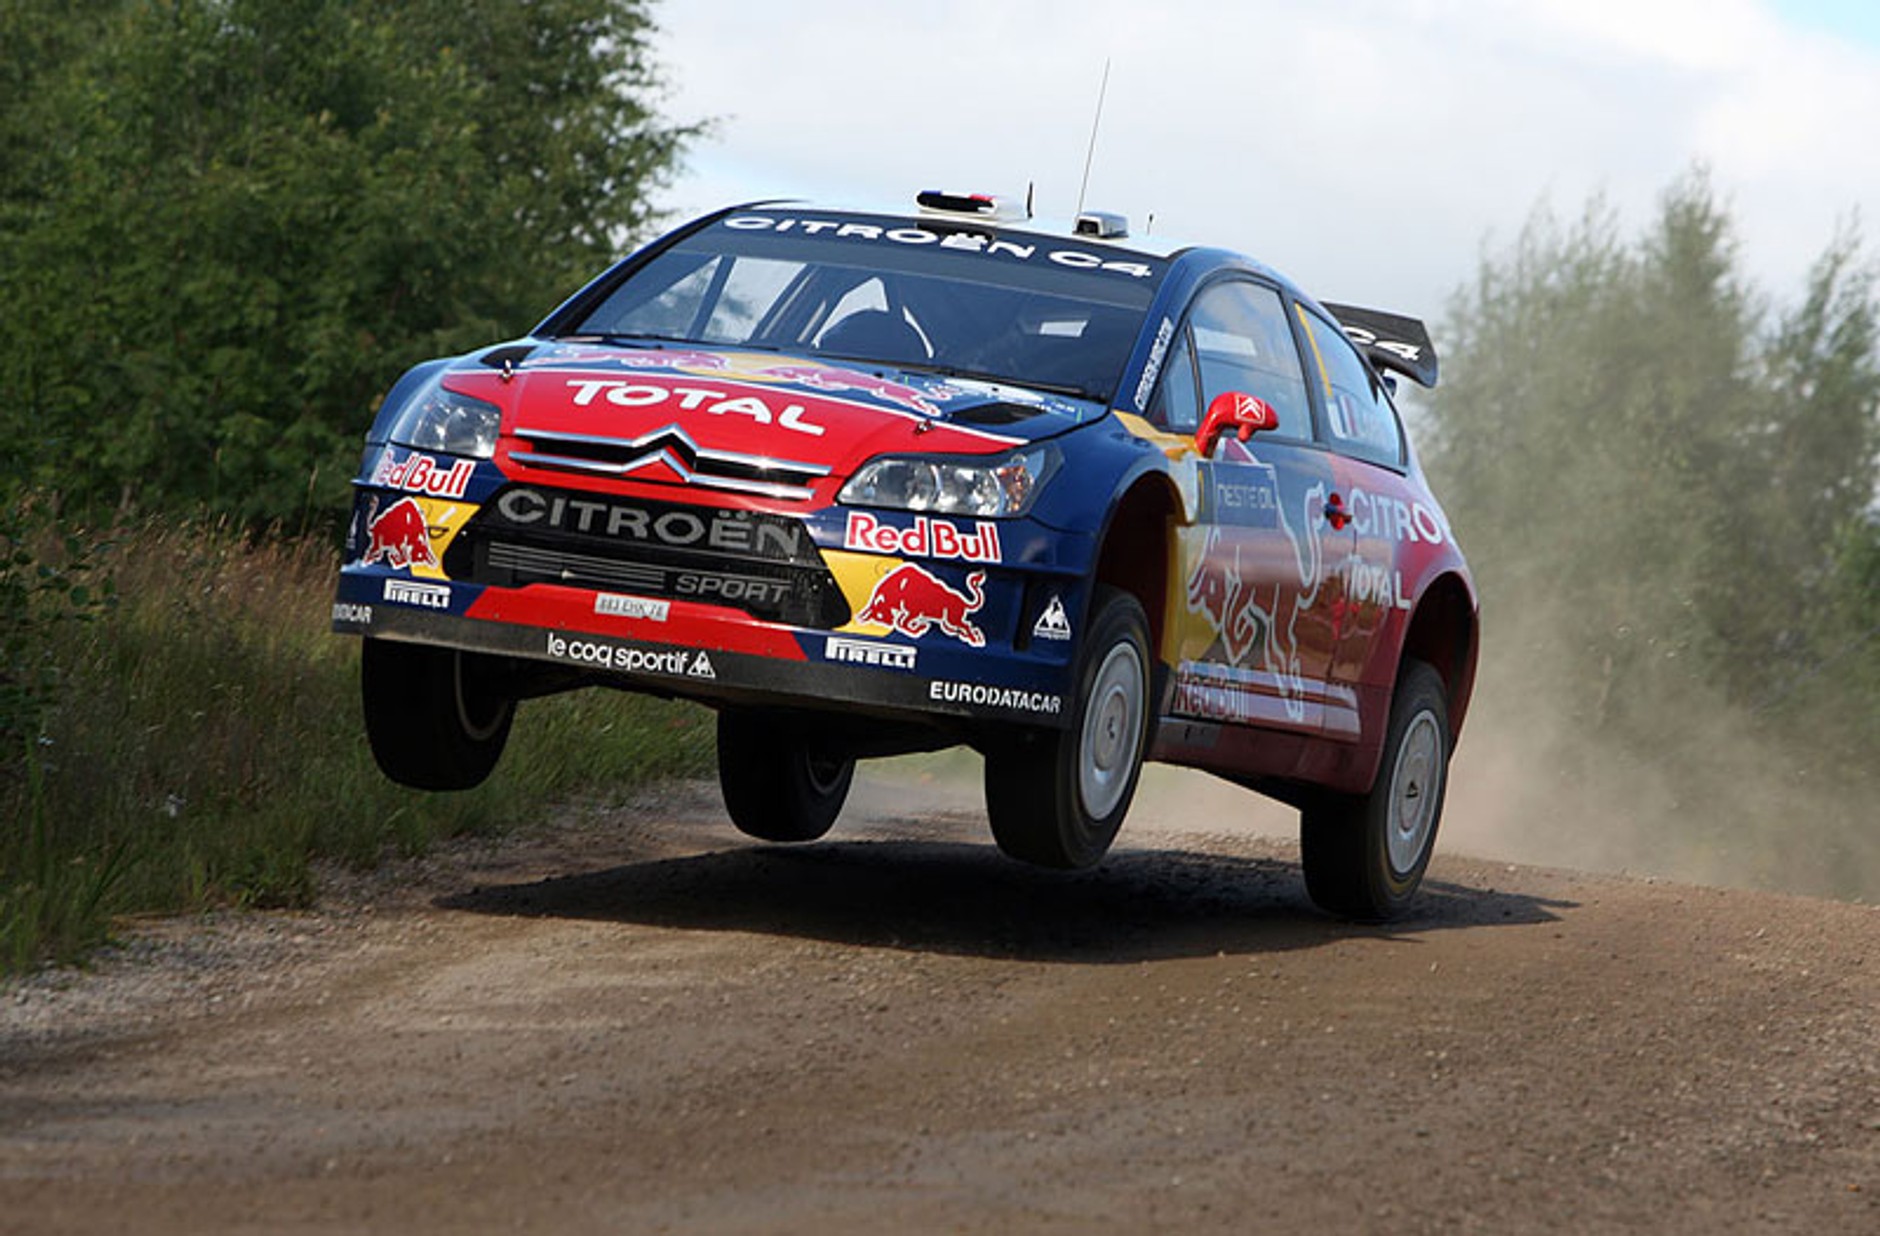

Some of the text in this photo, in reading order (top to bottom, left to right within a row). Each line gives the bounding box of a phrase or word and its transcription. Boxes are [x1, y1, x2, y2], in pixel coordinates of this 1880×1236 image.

[1048, 251, 1152, 277] C4
[566, 379, 825, 436] TOTAL
[404, 456, 476, 497] Bull
[498, 489, 800, 553] CITROËN
[845, 511, 1001, 563] Red Bull
[383, 578, 450, 608] PIRELLI
[676, 575, 792, 603] SPORT
[1344, 553, 1411, 610] TOTAL
[548, 632, 688, 674] le coq sportif
[825, 637, 917, 669] PIRELLI
[930, 681, 1061, 713] EURODATACAR
